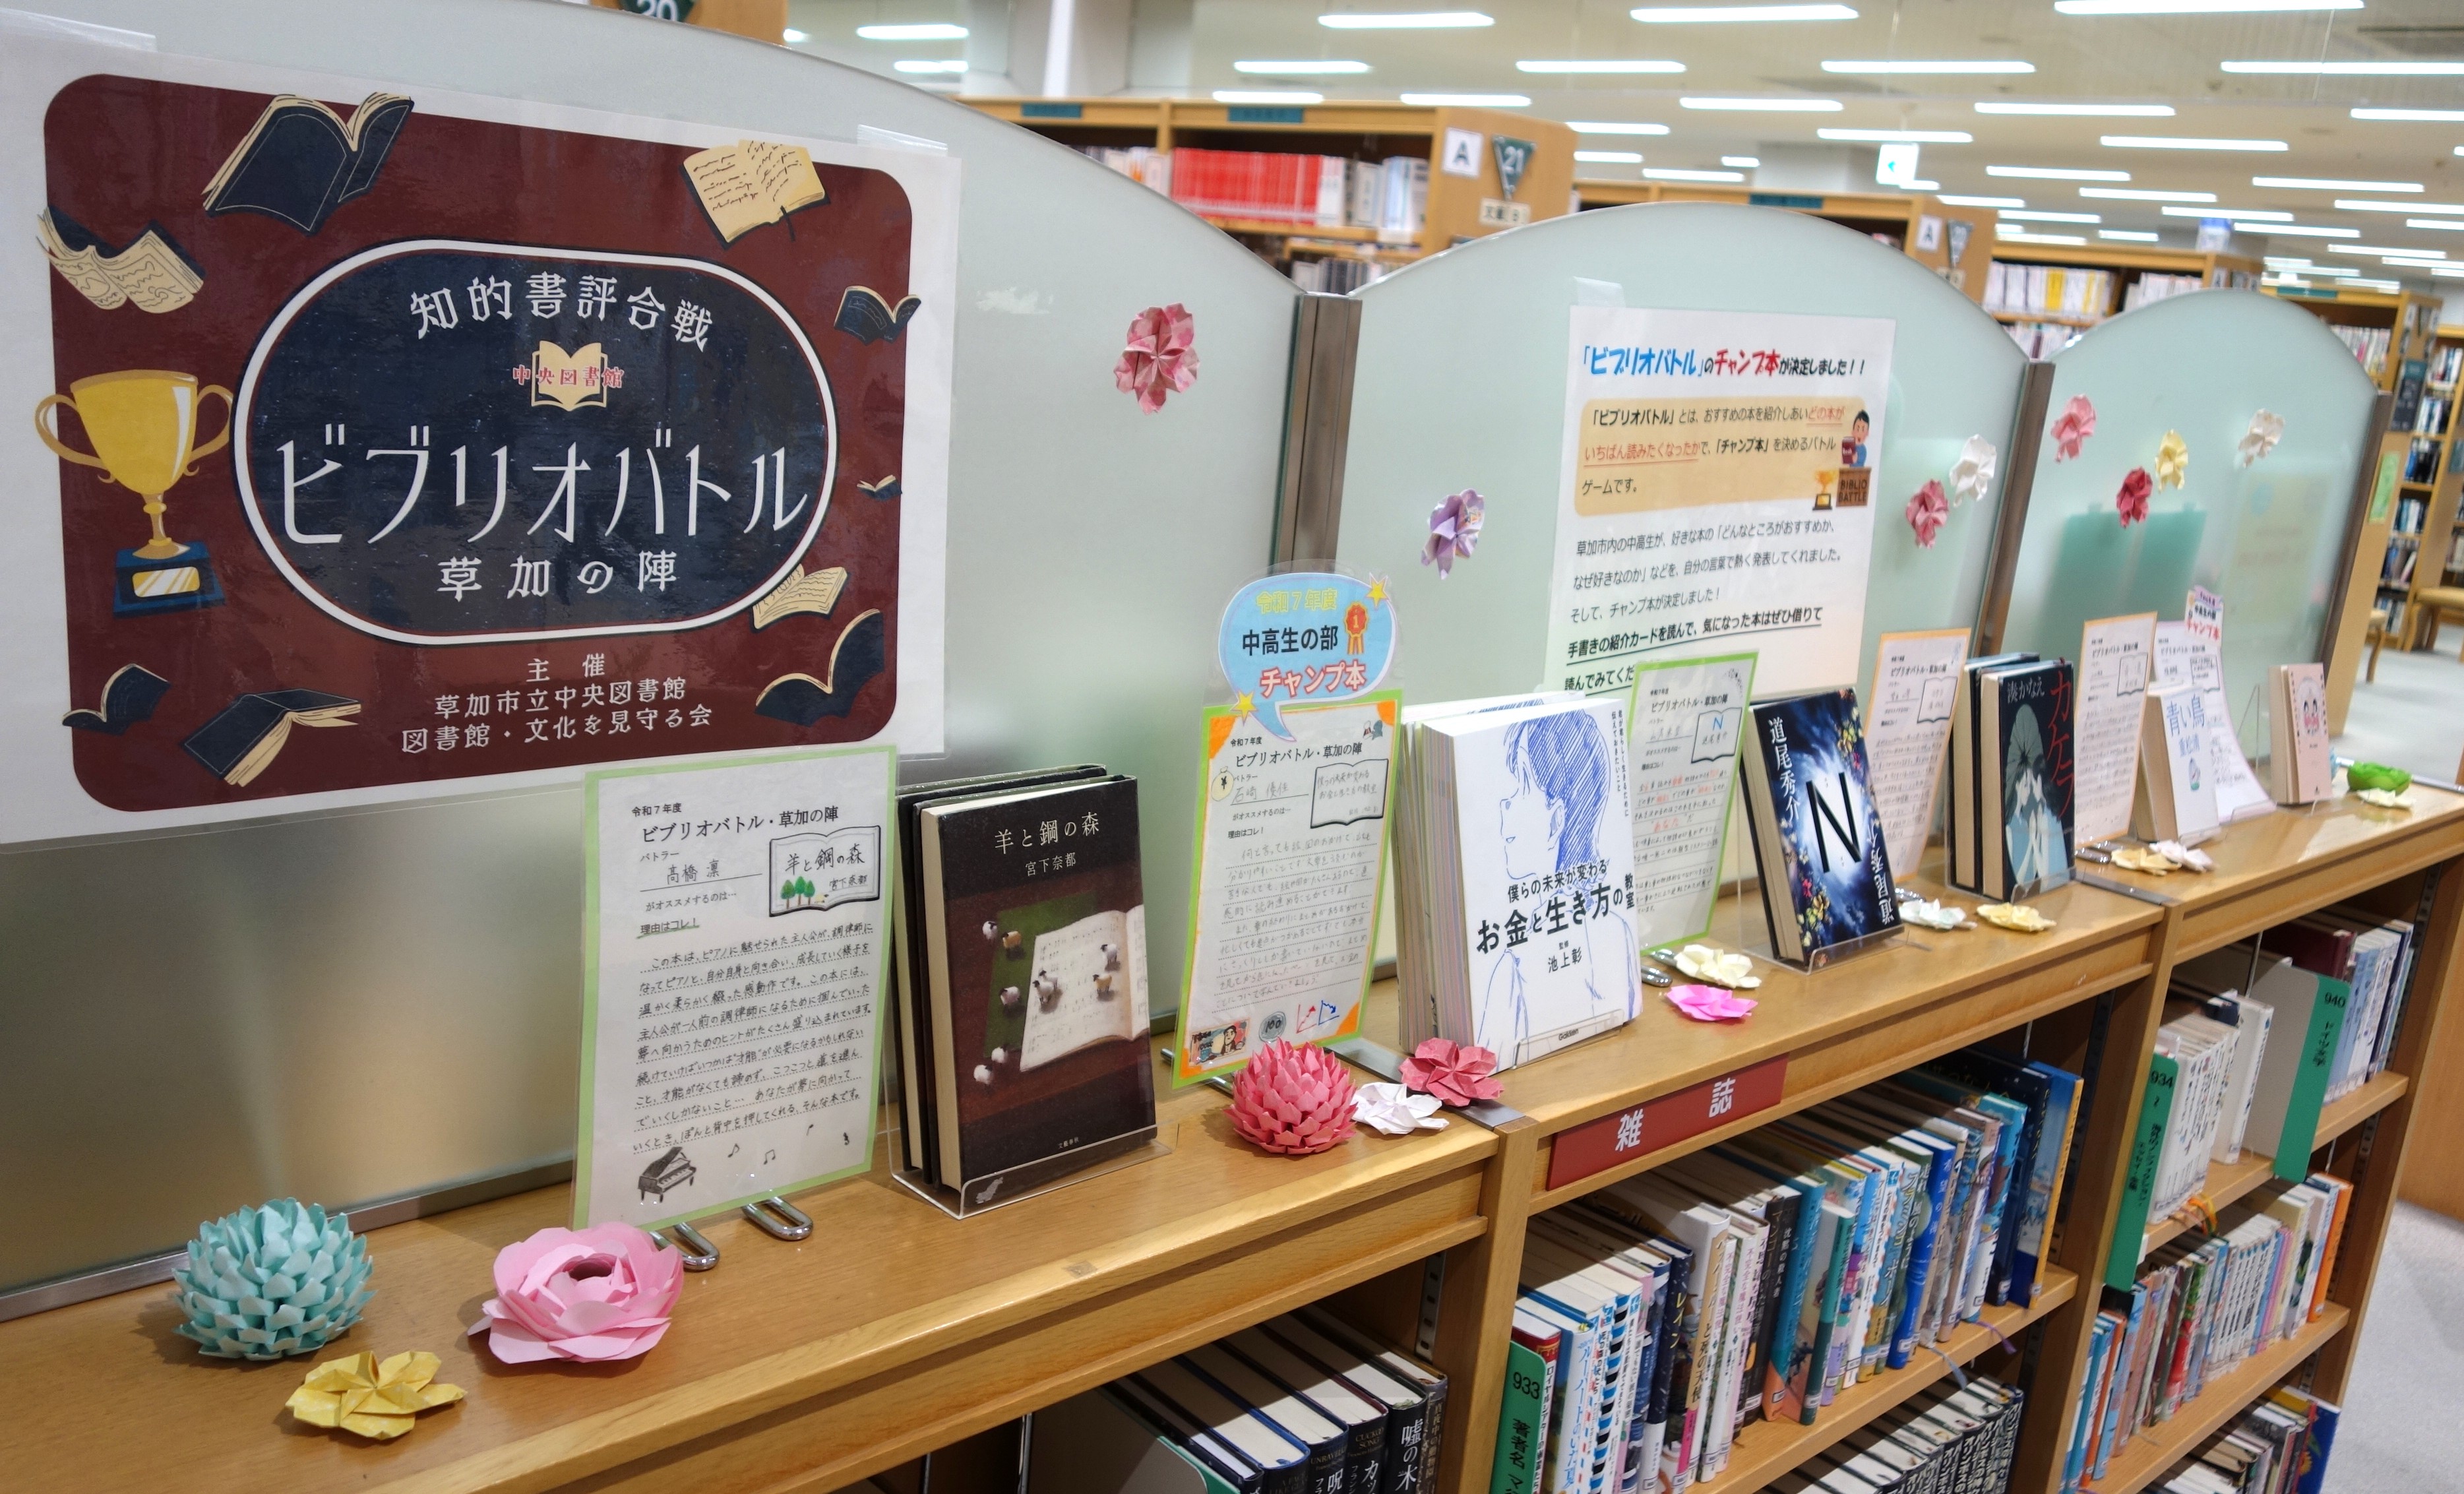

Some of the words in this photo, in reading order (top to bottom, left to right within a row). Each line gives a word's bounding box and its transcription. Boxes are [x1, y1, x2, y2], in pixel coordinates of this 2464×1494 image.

[1453, 140, 1470, 166] A
[1502, 146, 1524, 173] 21
[1923, 224, 1933, 243] A
[411, 271, 713, 352] 知的書評合戦
[512, 365, 625, 389] 中央図書館
[276, 423, 809, 544] ビブリオバトル
[1582, 478, 1638, 497] ゲームです。
[1838, 489, 1868, 503] BATTLE
[1839, 479, 1868, 491] BIBLIO
[437, 549, 678, 602] 草加の陣
[1242, 625, 1339, 656] 中高生の部
[526, 652, 606, 683] 主催
[1259, 659, 1367, 699] チャンプ本
[434, 677, 687, 720] 草加市立中央図書館
[1651, 693, 1729, 713] ビブリオバトル・草加の陣
[2006, 675, 2046, 704] 湊かなえ
[401, 703, 713, 755] 図書館・文化を見守る会
[1713, 714, 1724, 730] N
[2165, 693, 2206, 737] 青い鳥
[1235, 742, 1363, 768] ビブリオバトル・草加の陣
[2047, 670, 2075, 819] カケラ
[2178, 733, 2201, 759] 重松清
[1768, 716, 1801, 823] 道尾秀介
[632, 802, 682, 818] 令和7年度
[642, 805, 840, 844] ビブリオバトル・草加の陣
[1805, 771, 1863, 875] N
[995, 811, 1100, 855] 羊と鋼の森
[639, 851, 680, 863] バトラー
[785, 842, 866, 876] 羊と鋼の森
[1025, 852, 1076, 877] 宮下奈都
[1507, 859, 1608, 904] 僕らの未来が変わる
[1476, 873, 1635, 954] お金と生き方の教室
[1558, 940, 1569, 950] 監修
[1548, 947, 1583, 974] 池上彰
[2324, 991, 2347, 1009] 940
[1265, 1019, 1282, 1034] 100
[1558, 1028, 1579, 1041] Gakken
[2150, 1070, 2174, 1088] 934
[1615, 1077, 1737, 1152] 雑誌
[1670, 1292, 1687, 1350] レイン
[1512, 1371, 1541, 1400] 933
[1394, 1418, 1423, 1491] 嘘の木
[1509, 1417, 1531, 1470] 著者名
